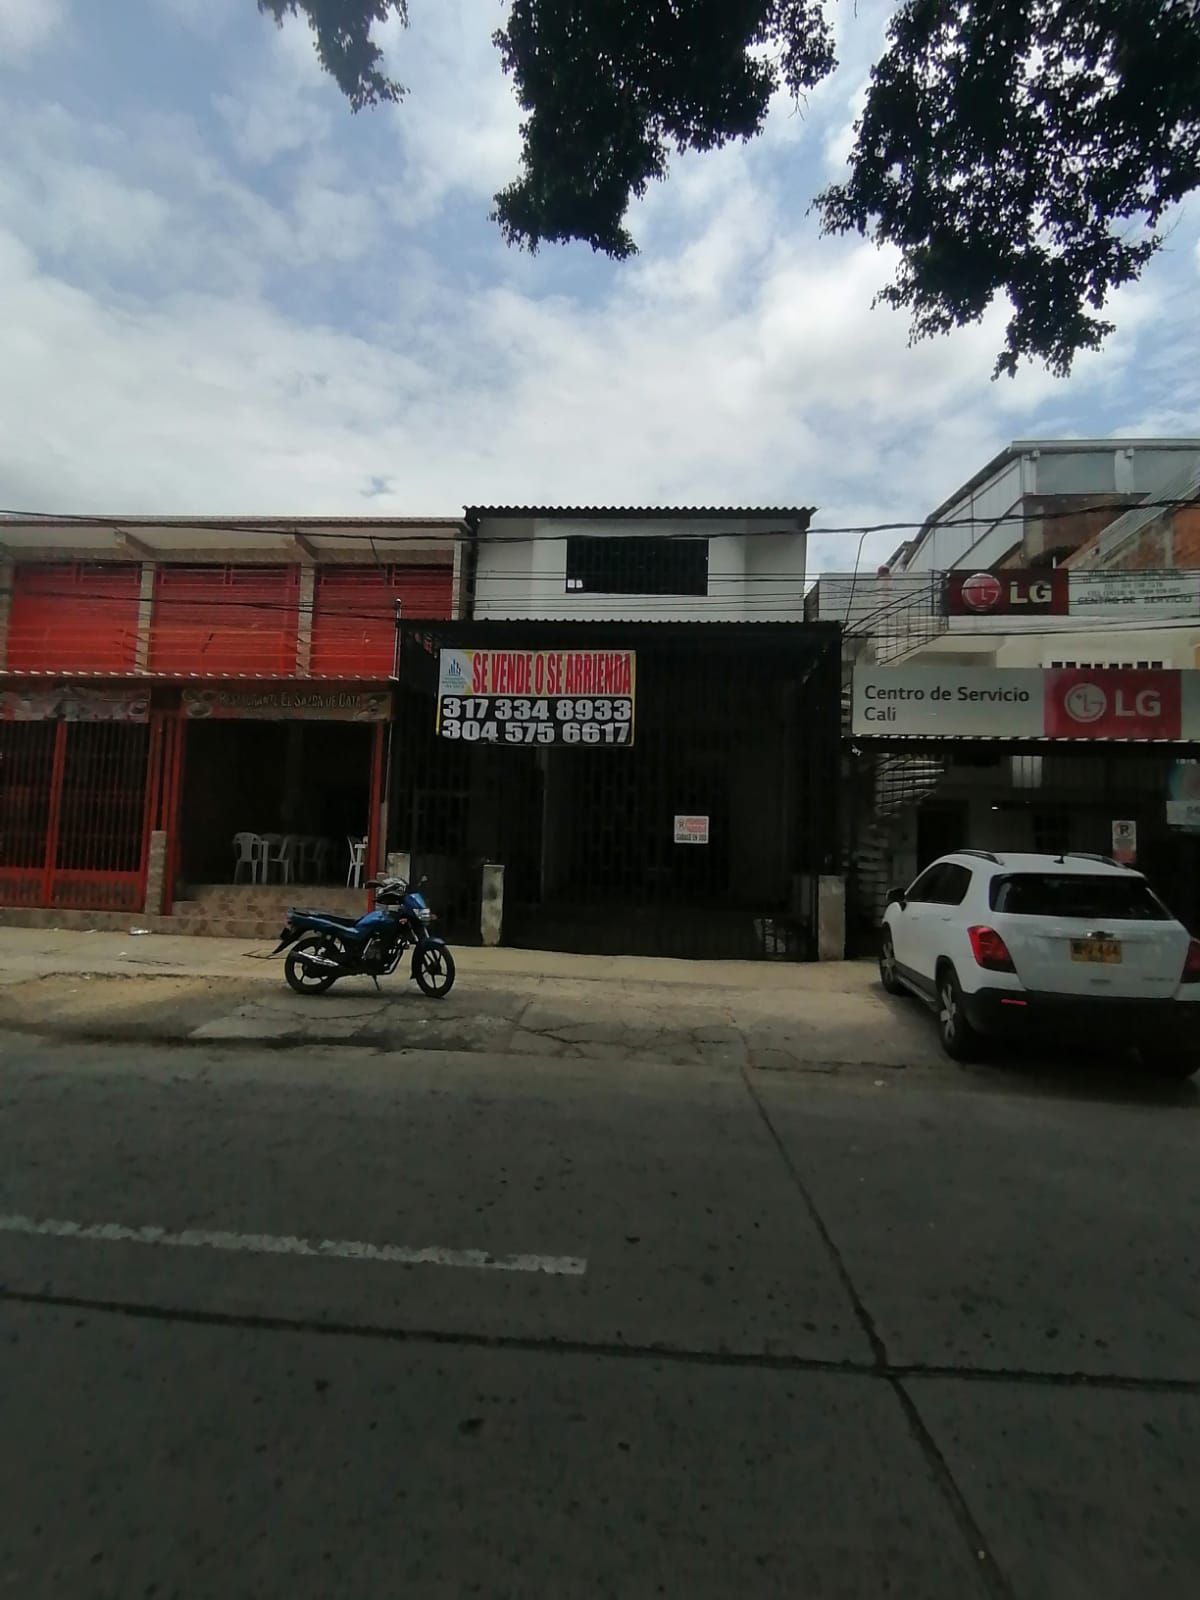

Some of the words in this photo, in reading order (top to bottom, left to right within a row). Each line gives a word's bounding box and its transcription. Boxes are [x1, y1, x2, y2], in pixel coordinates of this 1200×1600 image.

[1010, 581, 1052, 604] LG
[472, 653, 488, 694] SE
[491, 653, 532, 694] VENDE
[535, 653, 544, 695] O
[547, 653, 562, 695] SE
[565, 653, 631, 695] ARRIENDA
[865, 685, 924, 700] Centro
[930, 686, 952, 700] de
[958, 687, 1029, 702] Servicio
[1115, 690, 1161, 717] LG
[443, 698, 489, 719] 317
[495, 699, 549, 720] 334
[556, 699, 631, 721] 8933
[864, 707, 896, 721] Cali
[442, 719, 498, 741] 304
[505, 722, 554, 743] 575
[562, 722, 630, 743] 6617
